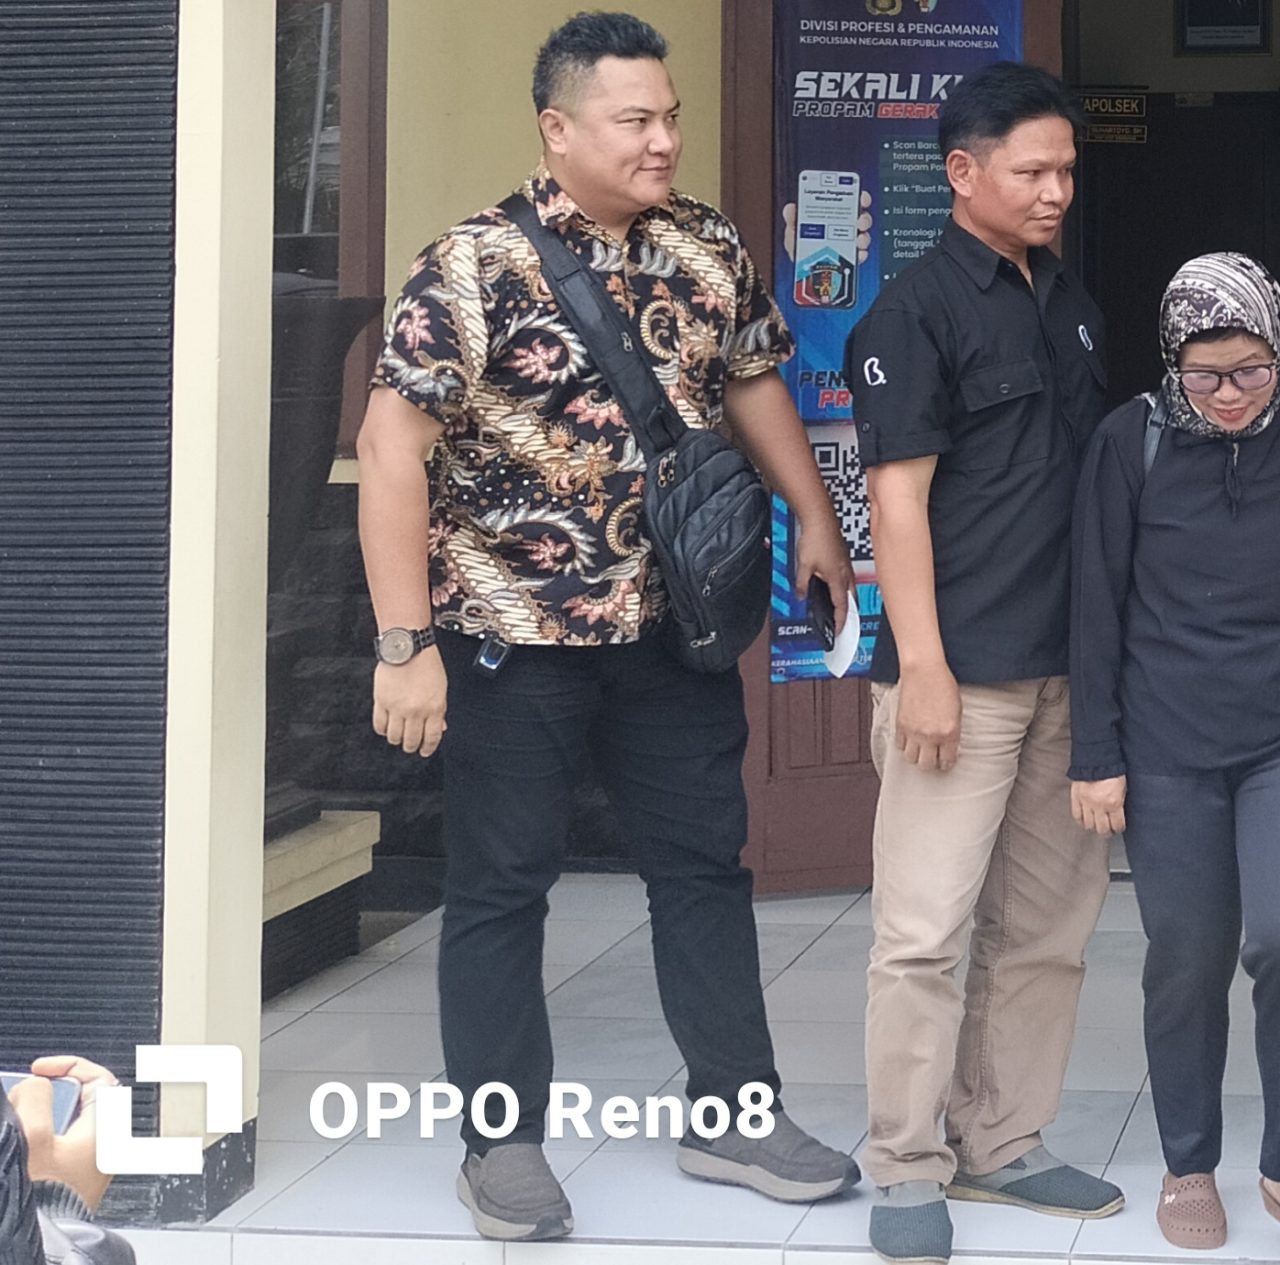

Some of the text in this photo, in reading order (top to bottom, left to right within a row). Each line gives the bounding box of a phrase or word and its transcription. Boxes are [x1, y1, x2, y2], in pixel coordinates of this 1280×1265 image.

[800, 20, 999, 36] DIVISI PROFESI & PENGAMANAN
[800, 35, 999, 49] KEPOLISIAN NEGARA REPUBLIK INDONESIA
[794, 71, 921, 100] SEKALI
[793, 100, 941, 119] PROPAM GERAK
[1081, 98, 1139, 113] APOLSEK
[893, 141, 940, 149] Scan Barc
[893, 152, 924, 160] tertera
[893, 163, 929, 172] Propam
[893, 206, 952, 217] Isi form peng
[893, 228, 937, 238] Kronologi
[893, 250, 919, 258] detail
